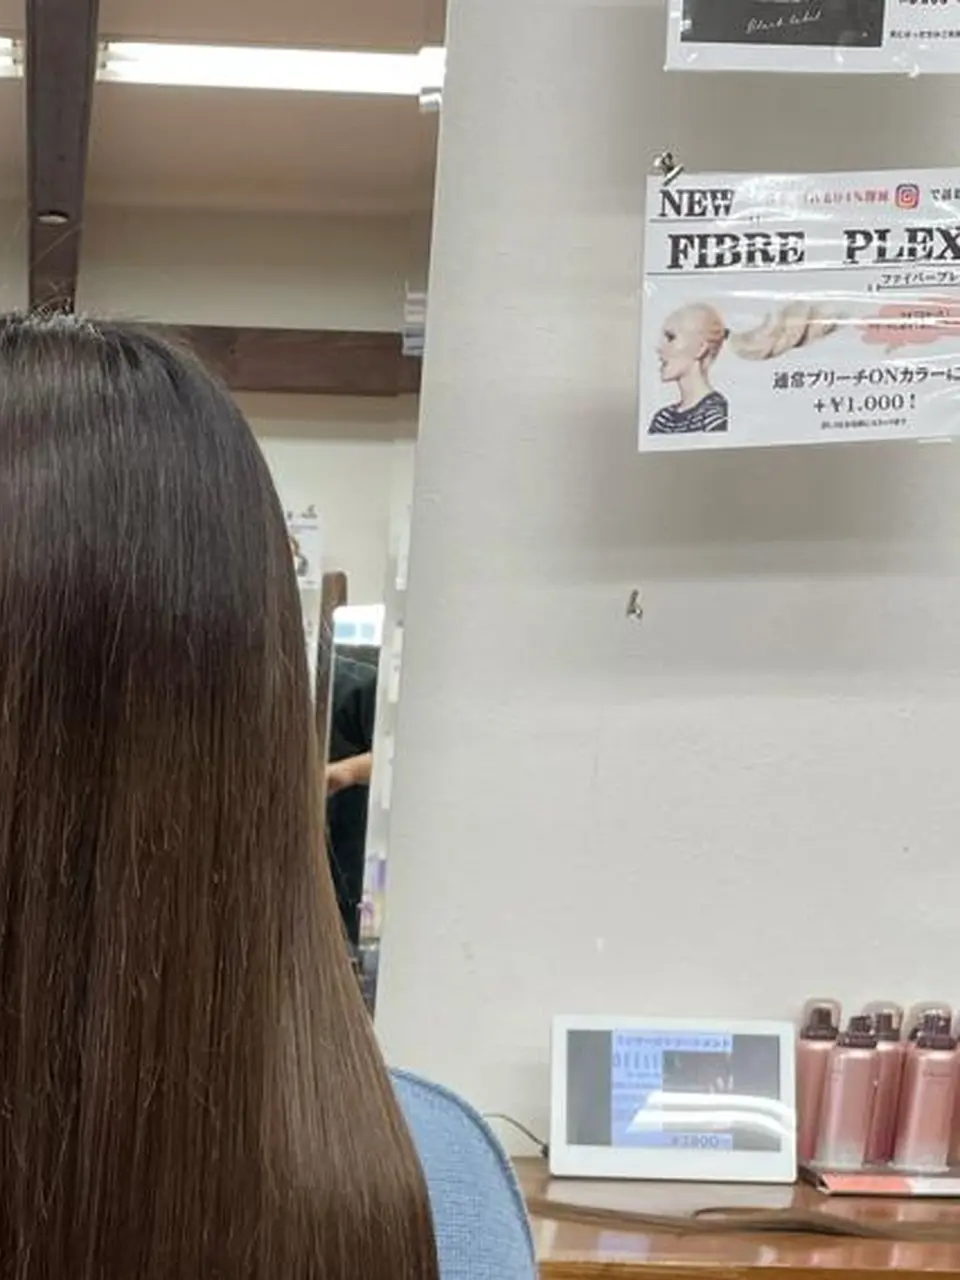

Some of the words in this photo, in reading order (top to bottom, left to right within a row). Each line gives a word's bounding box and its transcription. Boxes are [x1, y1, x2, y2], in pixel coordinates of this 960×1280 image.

[658, 188, 735, 217] NEW
[666, 231, 805, 269] FIBRE
[842, 226, 960, 265] PLEX
